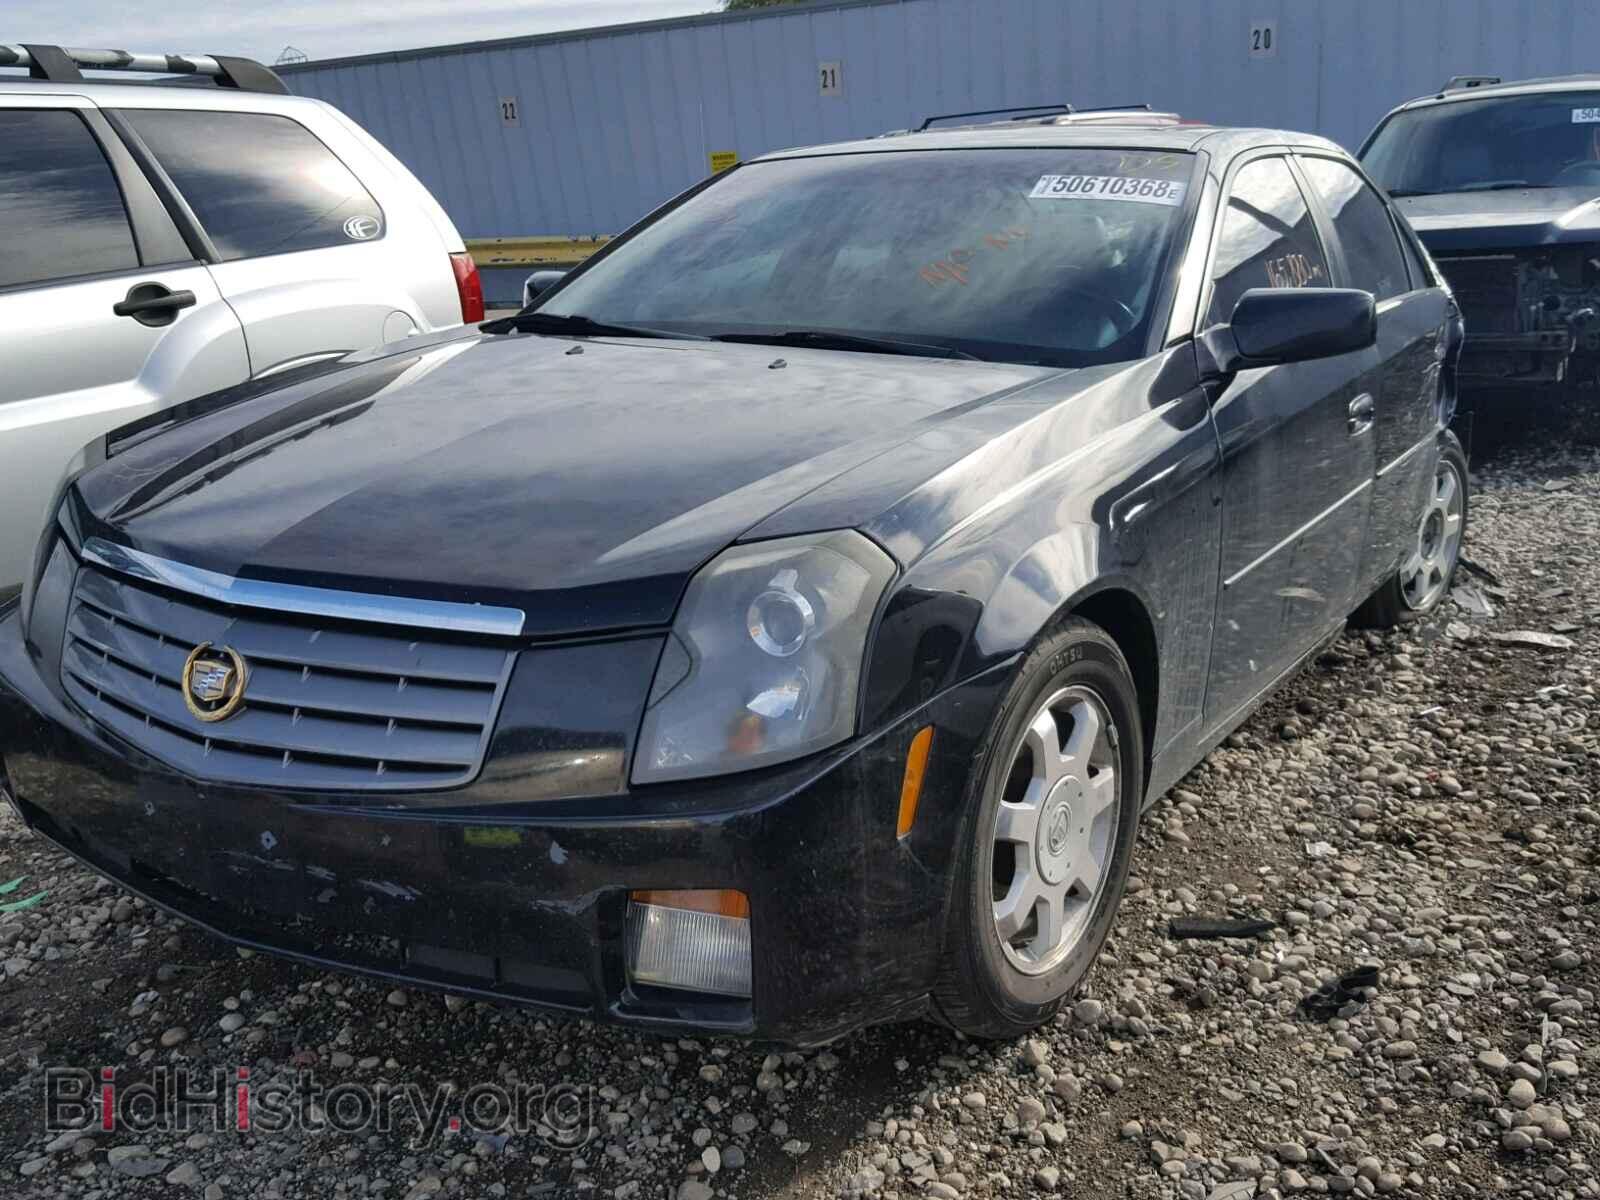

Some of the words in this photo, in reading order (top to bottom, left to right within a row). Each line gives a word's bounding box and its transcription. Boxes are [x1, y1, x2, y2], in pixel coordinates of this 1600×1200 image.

[1253, 28, 1271, 50] 20
[821, 69, 836, 89] 21
[502, 102, 517, 120] 22
